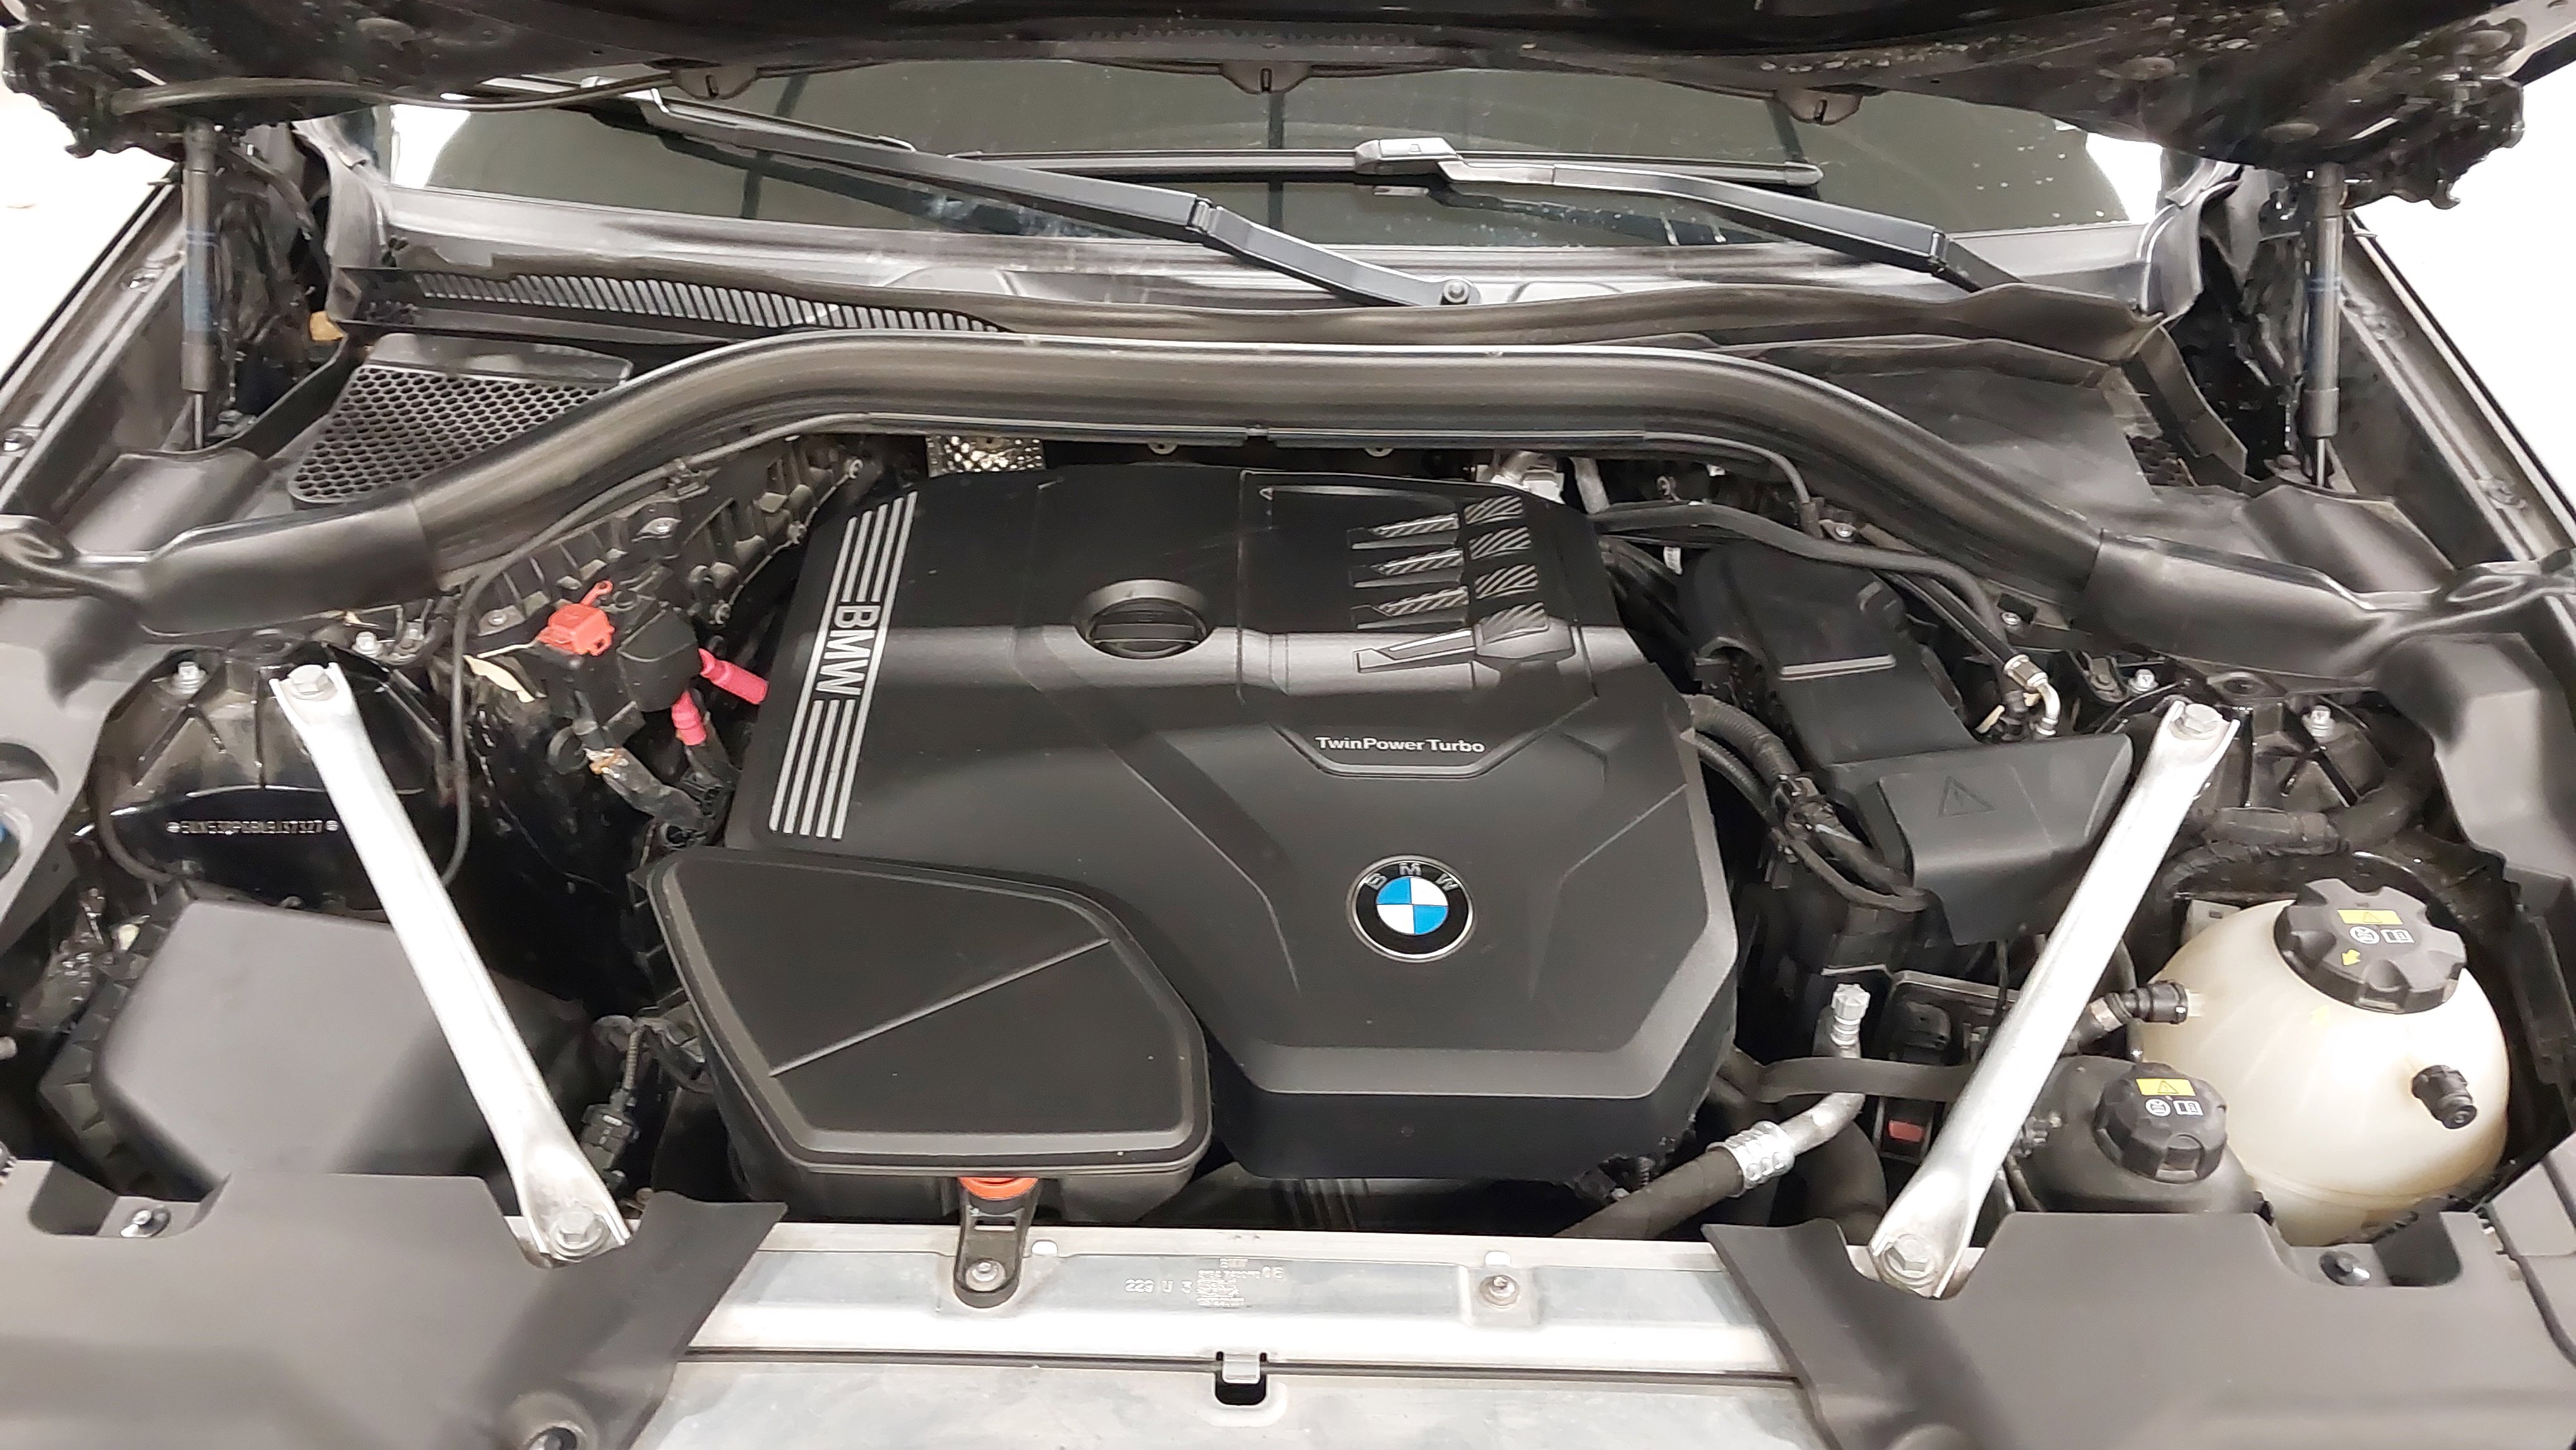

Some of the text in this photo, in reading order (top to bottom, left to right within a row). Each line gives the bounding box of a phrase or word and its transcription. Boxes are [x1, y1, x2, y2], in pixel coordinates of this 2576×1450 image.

[814, 604, 881, 696] BMW
[1314, 736, 1486, 753] TwinPower Turbo
[1363, 861, 1460, 891] BMW
